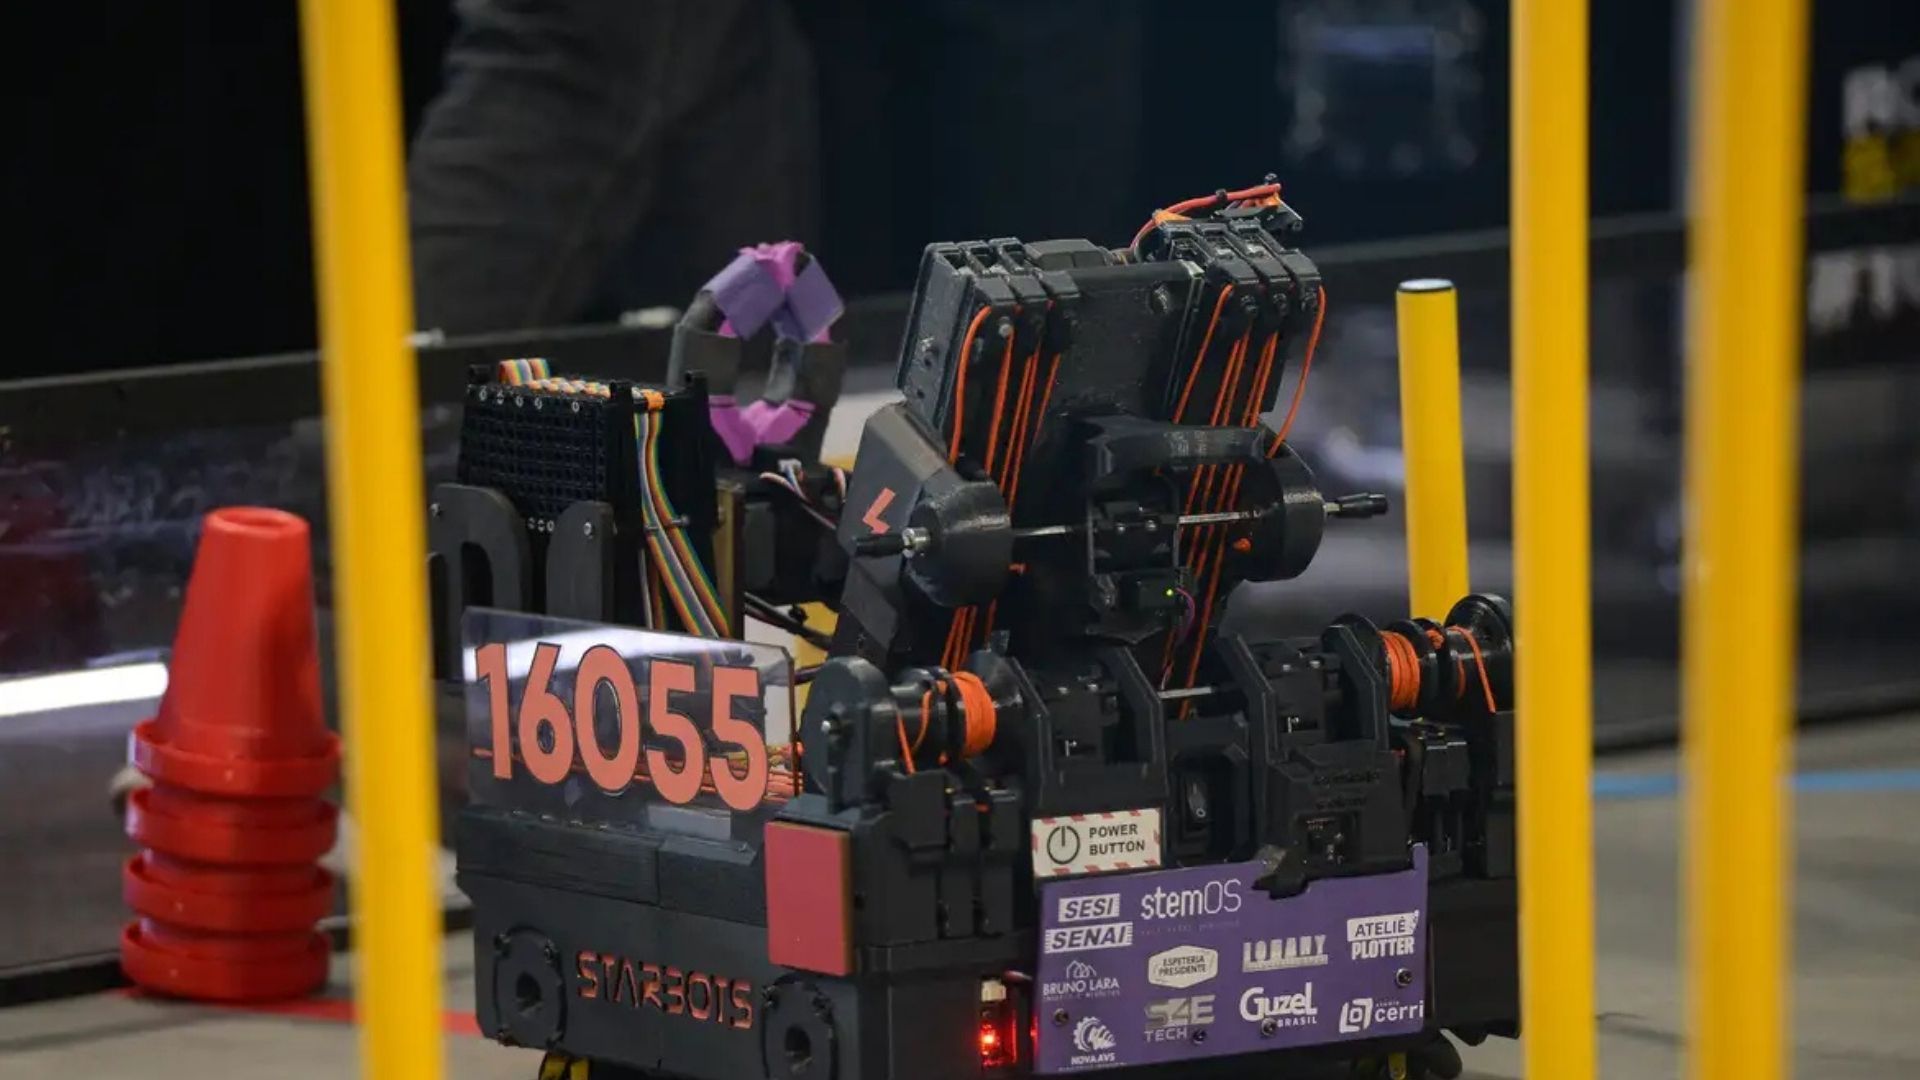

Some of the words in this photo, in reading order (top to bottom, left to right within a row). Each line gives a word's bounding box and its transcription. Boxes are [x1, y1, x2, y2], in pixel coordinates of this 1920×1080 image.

[475, 642, 768, 812] 16055
[1089, 824, 1138, 838] POWER
[1089, 840, 1145, 856] BUTTON
[1064, 897, 1114, 919] SESI
[1141, 878, 1242, 920] stemOS
[1052, 926, 1126, 949] SENAI
[1352, 936, 1415, 960] PLOTTER
[1158, 964, 1207, 976] PRESIDENTE
[577, 951, 753, 1030] STARBOTS
[1043, 980, 1087, 996] BRUNO
[1089, 977, 1120, 991] LARA
[1144, 995, 1216, 1031] S4E
[1277, 1016, 1318, 1028] BRASIL
[1374, 1000, 1424, 1022] cerri
[1144, 1026, 1187, 1043] TECH
